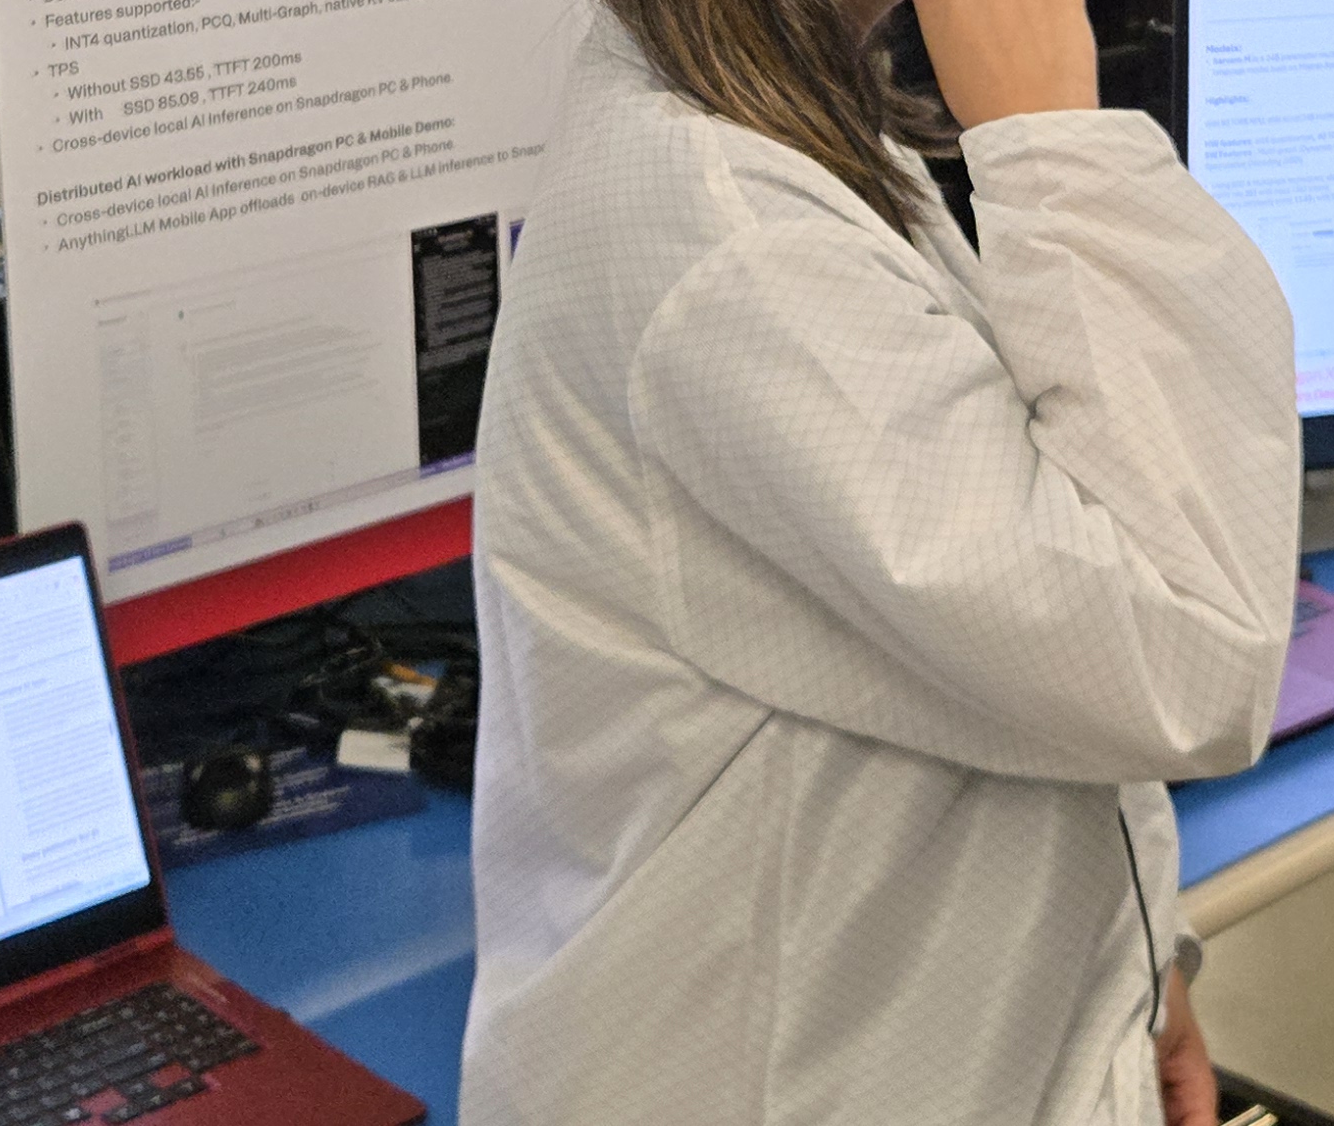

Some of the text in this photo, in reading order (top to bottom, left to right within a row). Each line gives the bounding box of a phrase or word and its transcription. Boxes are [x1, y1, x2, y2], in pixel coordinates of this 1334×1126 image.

[45, 8, 112, 27] Features
[47, 60, 78, 77] TPS
[37, 177, 122, 206] Distributed
[126, 174, 141, 189] AI
[145, 160, 211, 185] workload
[215, 155, 245, 171] with
[248, 140, 332, 165] Snapdragon
[335, 134, 353, 149] PC
[357, 132, 366, 145] &
[369, 124, 412, 142] Mobile
